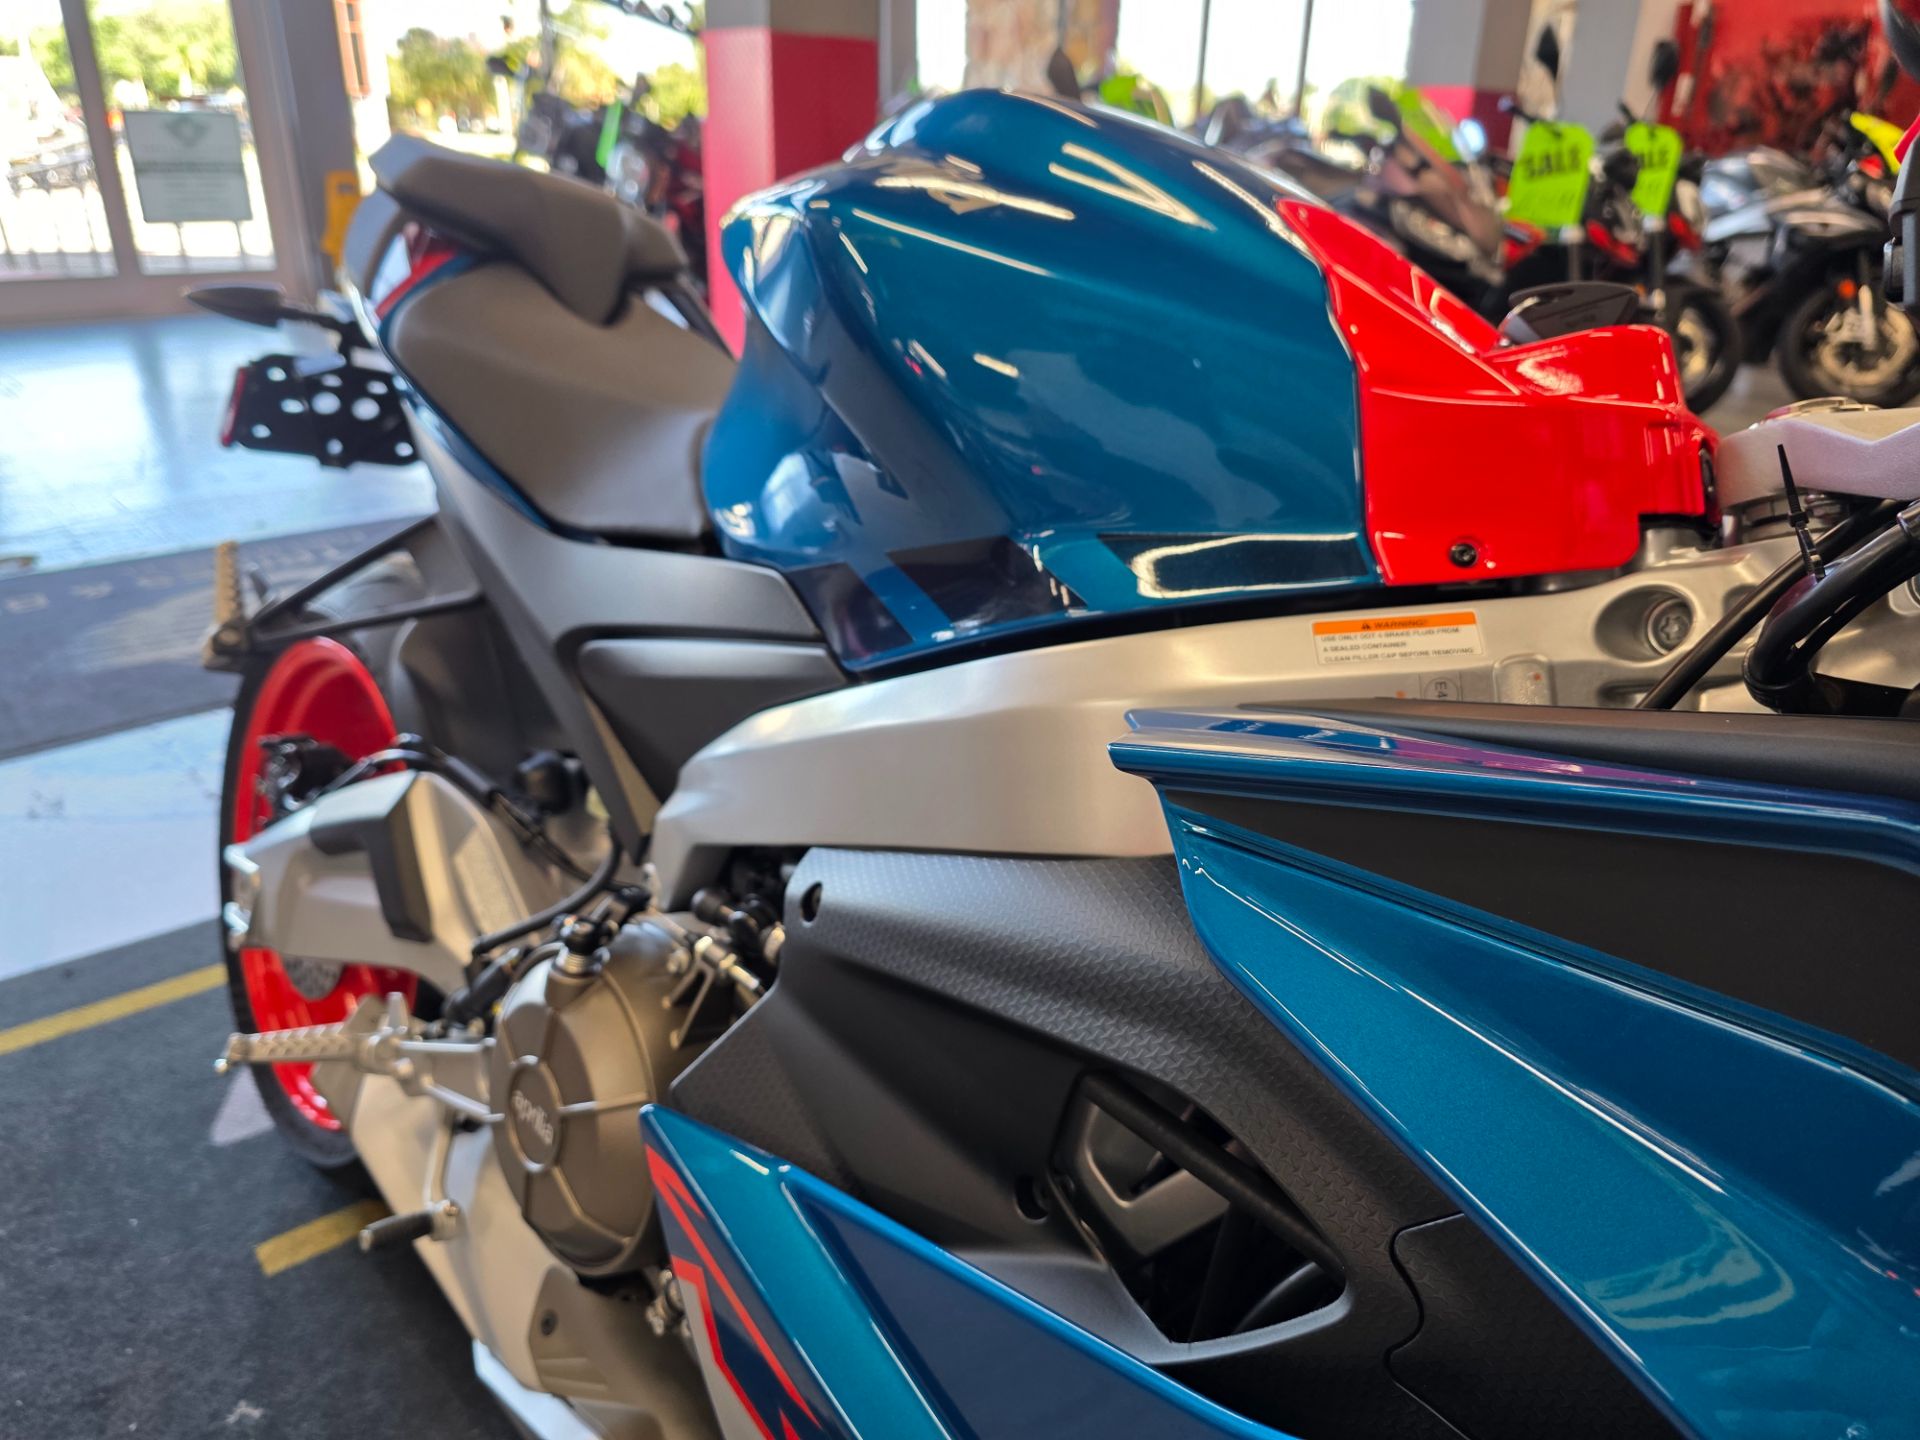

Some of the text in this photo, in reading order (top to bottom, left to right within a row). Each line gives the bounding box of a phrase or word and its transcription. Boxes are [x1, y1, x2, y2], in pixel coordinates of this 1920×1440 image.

[1523, 146, 1581, 179] SALE
[1338, 633, 1358, 641] ONLY
[1360, 632, 1375, 640] DOT
[1384, 630, 1409, 638] BRAKE
[1412, 629, 1436, 637] FLUID
[1437, 627, 1460, 635] FROM
[1330, 644, 1361, 652] SEALED
[1362, 641, 1407, 650] CONTAINER
[1325, 655, 1351, 663] CLEAN
[1352, 653, 1379, 661] FILLER
[1381, 652, 1397, 660] CAP
[1399, 650, 1430, 658] BEFORE
[1434, 681, 1448, 698] E4
[512, 1089, 554, 1145] aprilia
